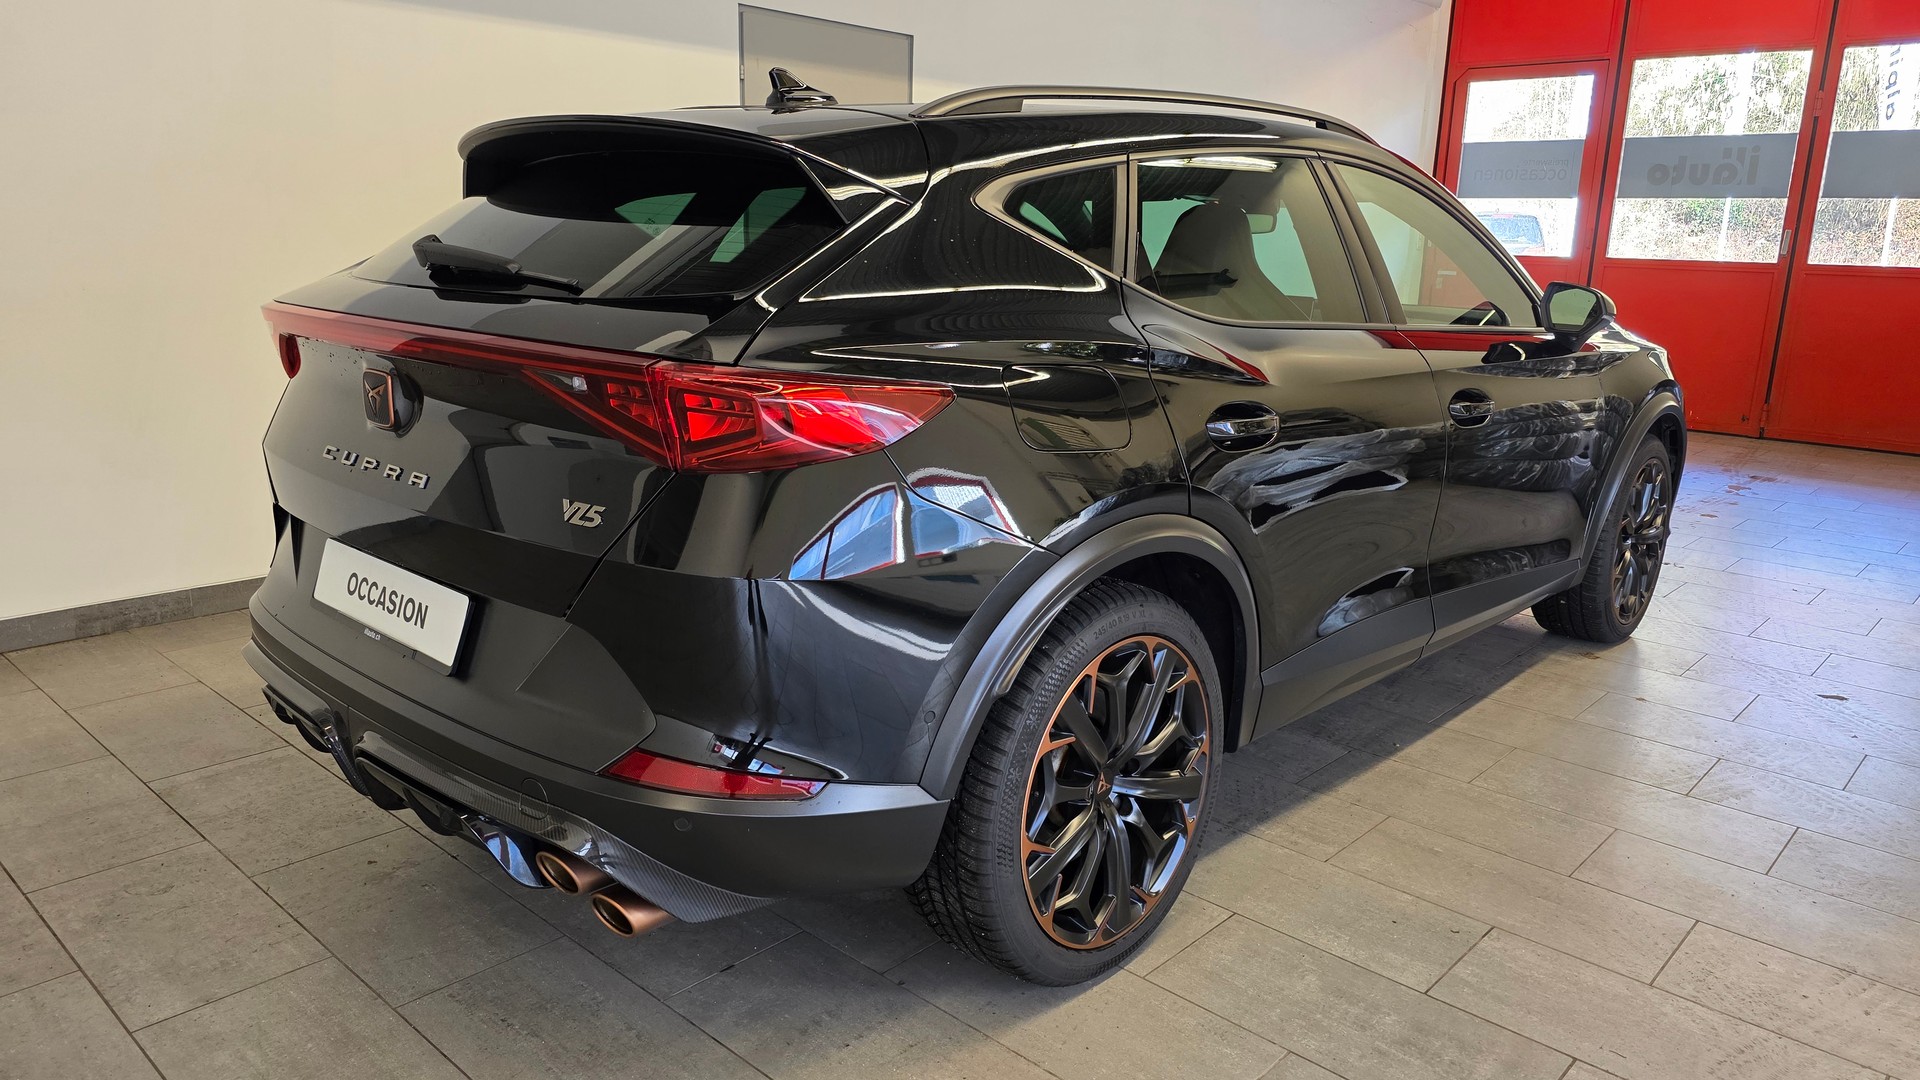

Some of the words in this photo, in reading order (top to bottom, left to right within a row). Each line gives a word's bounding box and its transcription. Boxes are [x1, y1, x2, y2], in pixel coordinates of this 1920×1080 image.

[323, 445, 430, 489] CUPRA
[347, 572, 428, 629] OCCASION
[1093, 618, 1117, 640] 245/40
